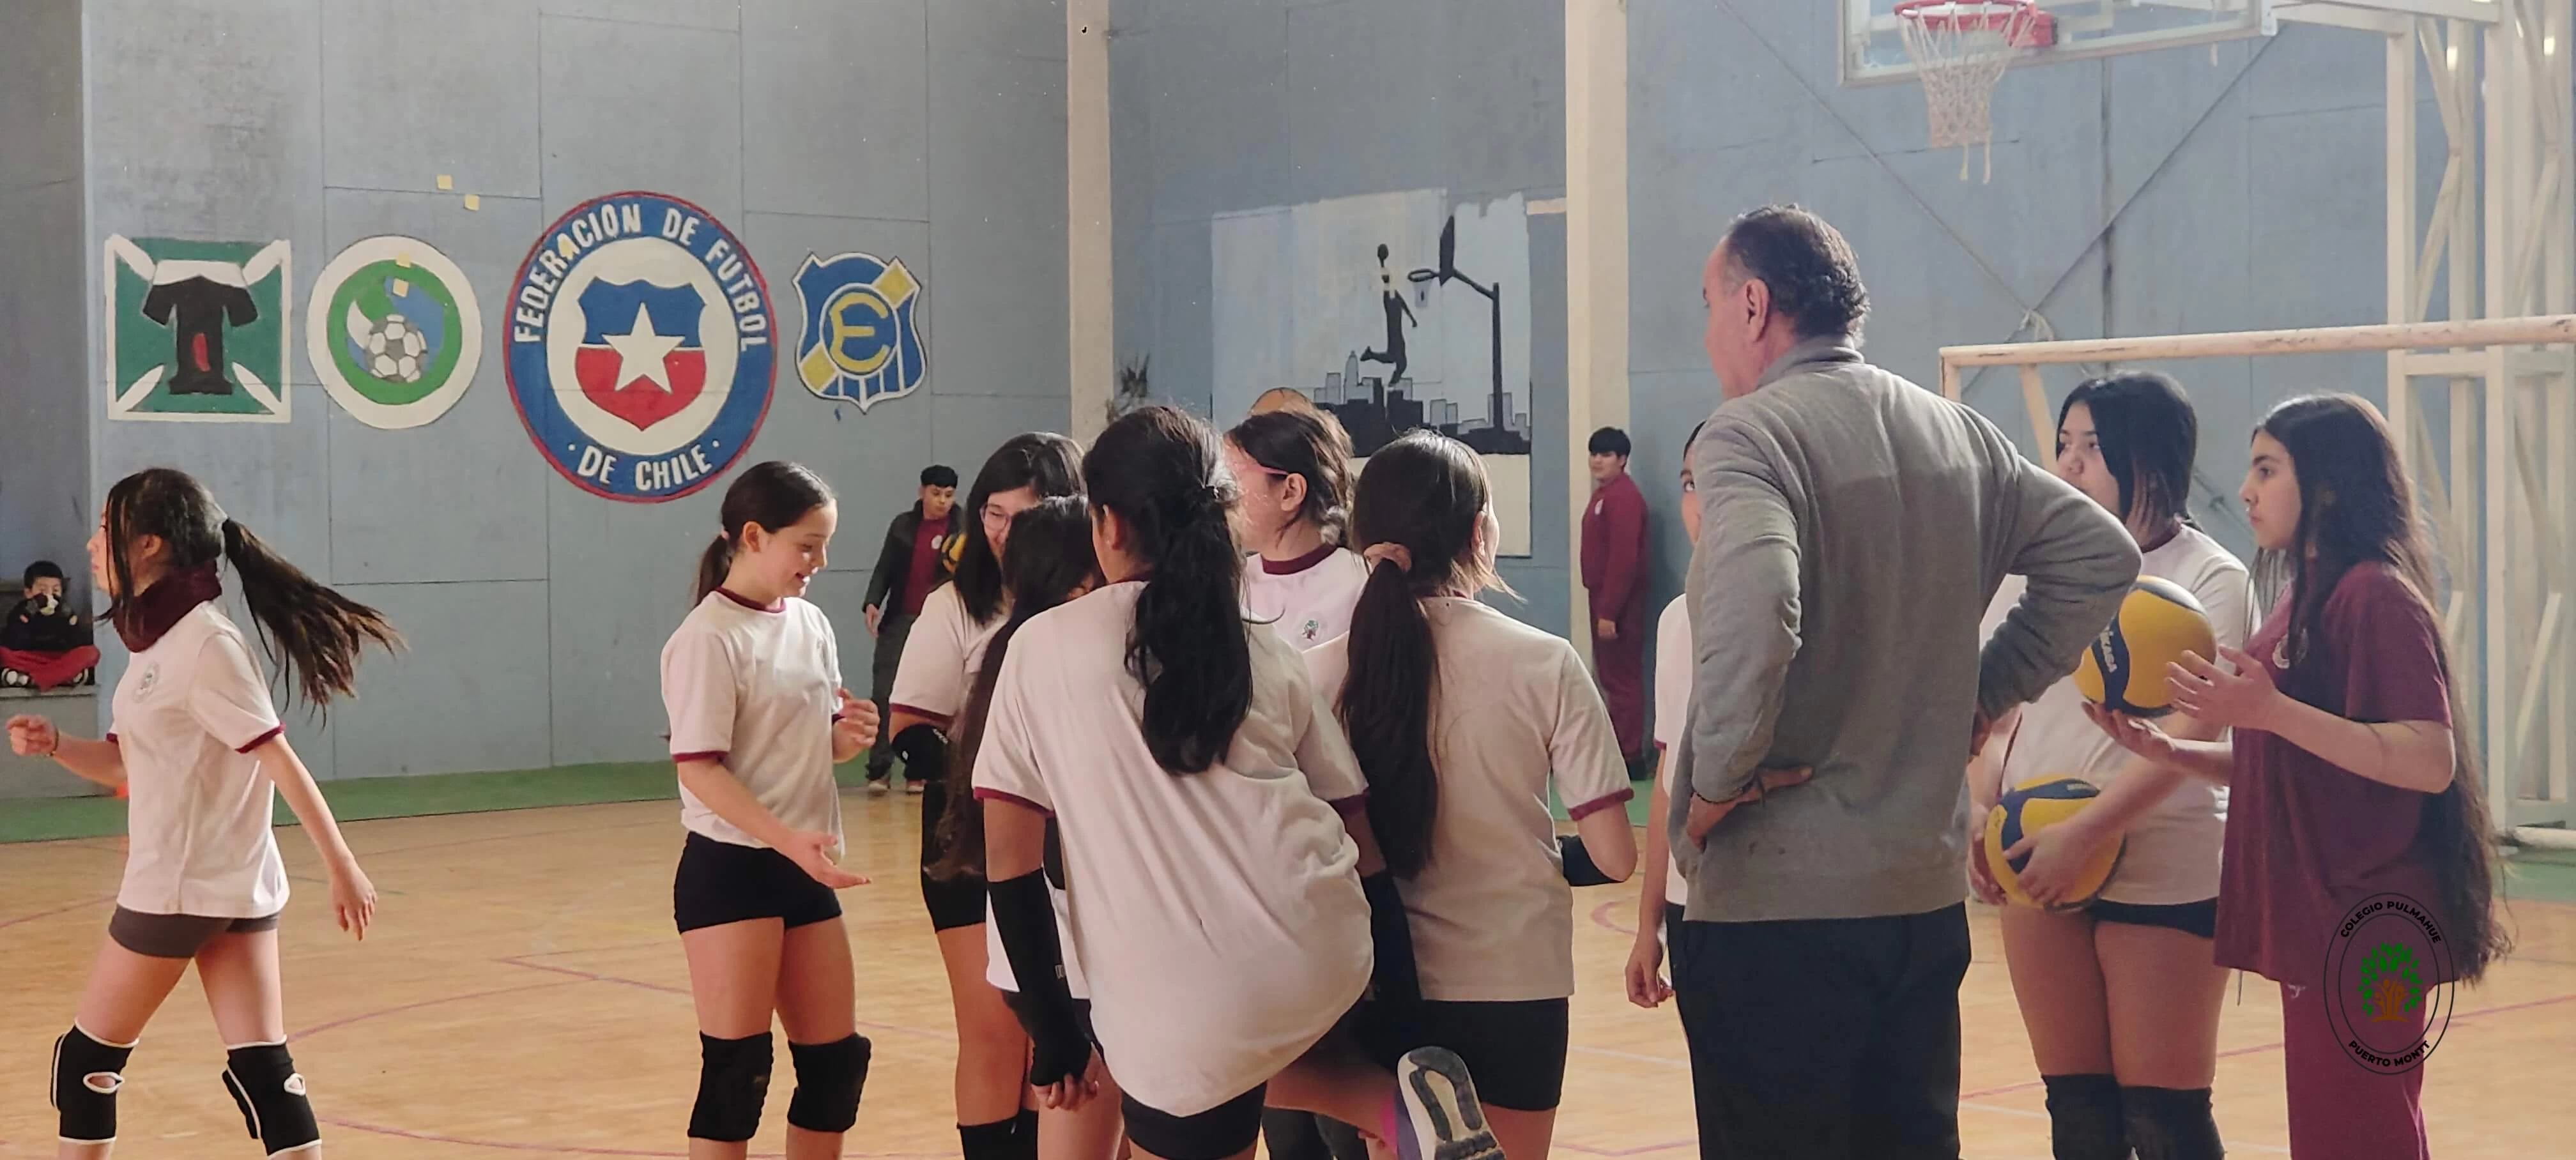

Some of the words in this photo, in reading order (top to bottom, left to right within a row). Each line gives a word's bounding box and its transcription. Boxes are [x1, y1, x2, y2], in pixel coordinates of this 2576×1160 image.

[514, 203, 641, 342] FEDERACION
[662, 208, 700, 246] DE
[705, 238, 767, 351] FUTBOL
[577, 445, 617, 485] DE
[635, 444, 712, 491] CHILE
